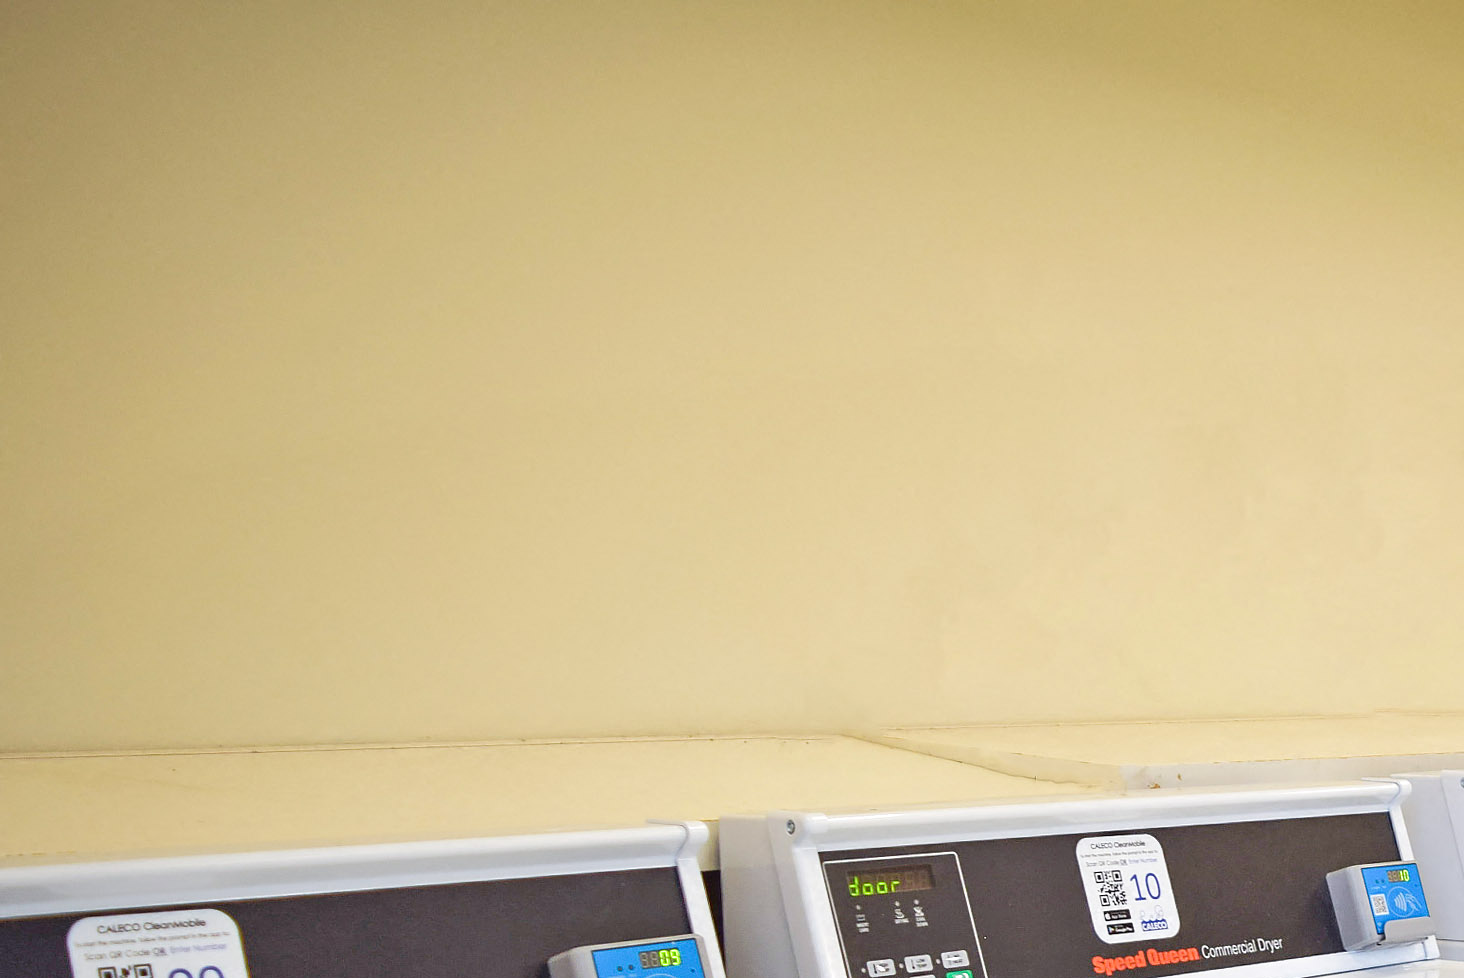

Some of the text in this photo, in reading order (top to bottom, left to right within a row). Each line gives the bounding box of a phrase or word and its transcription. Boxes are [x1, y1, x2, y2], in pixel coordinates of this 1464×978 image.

[1399, 869, 1410, 882] 10
[848, 875, 901, 897] door
[1130, 872, 1161, 901] 10
[96, 917, 207, 934] CALECO CleanMobile
[658, 948, 682, 967] 09
[1091, 937, 1284, 976] Speed Queen Commercial Dryer
